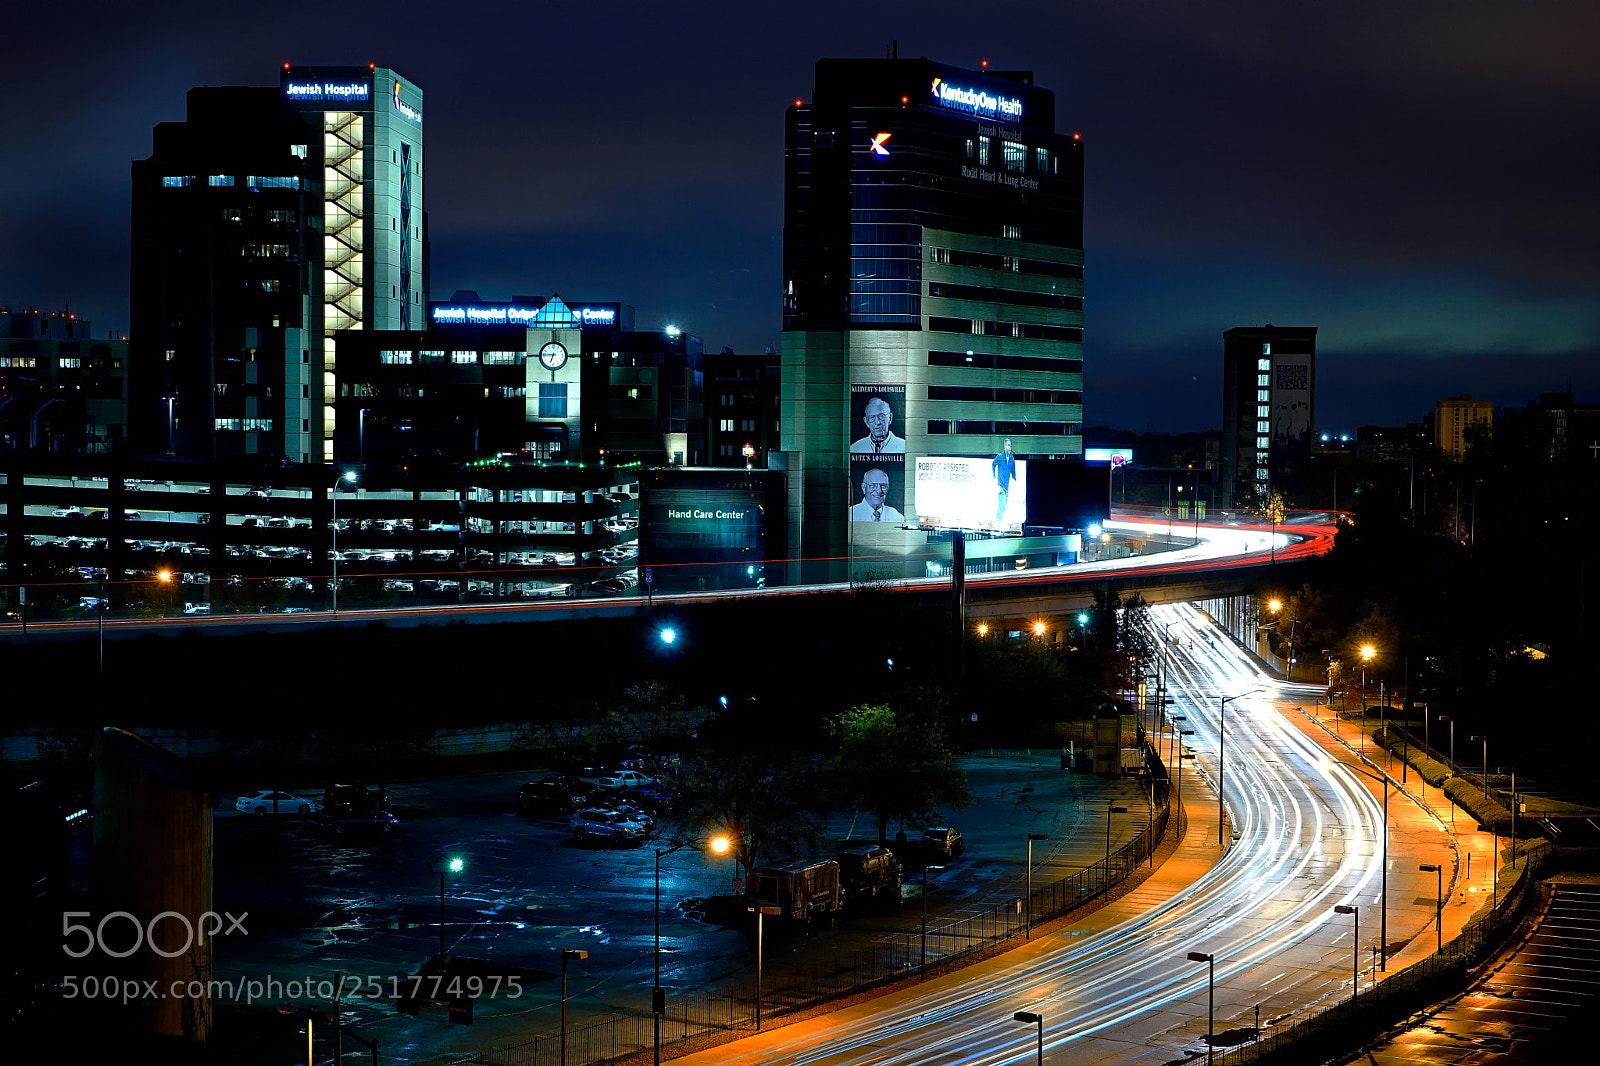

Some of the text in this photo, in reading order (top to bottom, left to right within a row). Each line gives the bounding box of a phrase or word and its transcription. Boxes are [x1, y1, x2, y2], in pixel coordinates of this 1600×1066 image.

[286, 83, 368, 97] Jewish Hospital
[940, 82, 1022, 116] KentuckyOne Health
[977, 122, 1022, 142] Jewish Hospital
[961, 165, 1039, 190] Rudd Heart & Lung Center
[433, 308, 466, 319] Jewish
[467, 308, 507, 321] Hospital
[582, 308, 615, 320] Center
[668, 509, 745, 519] Hand Care Center
